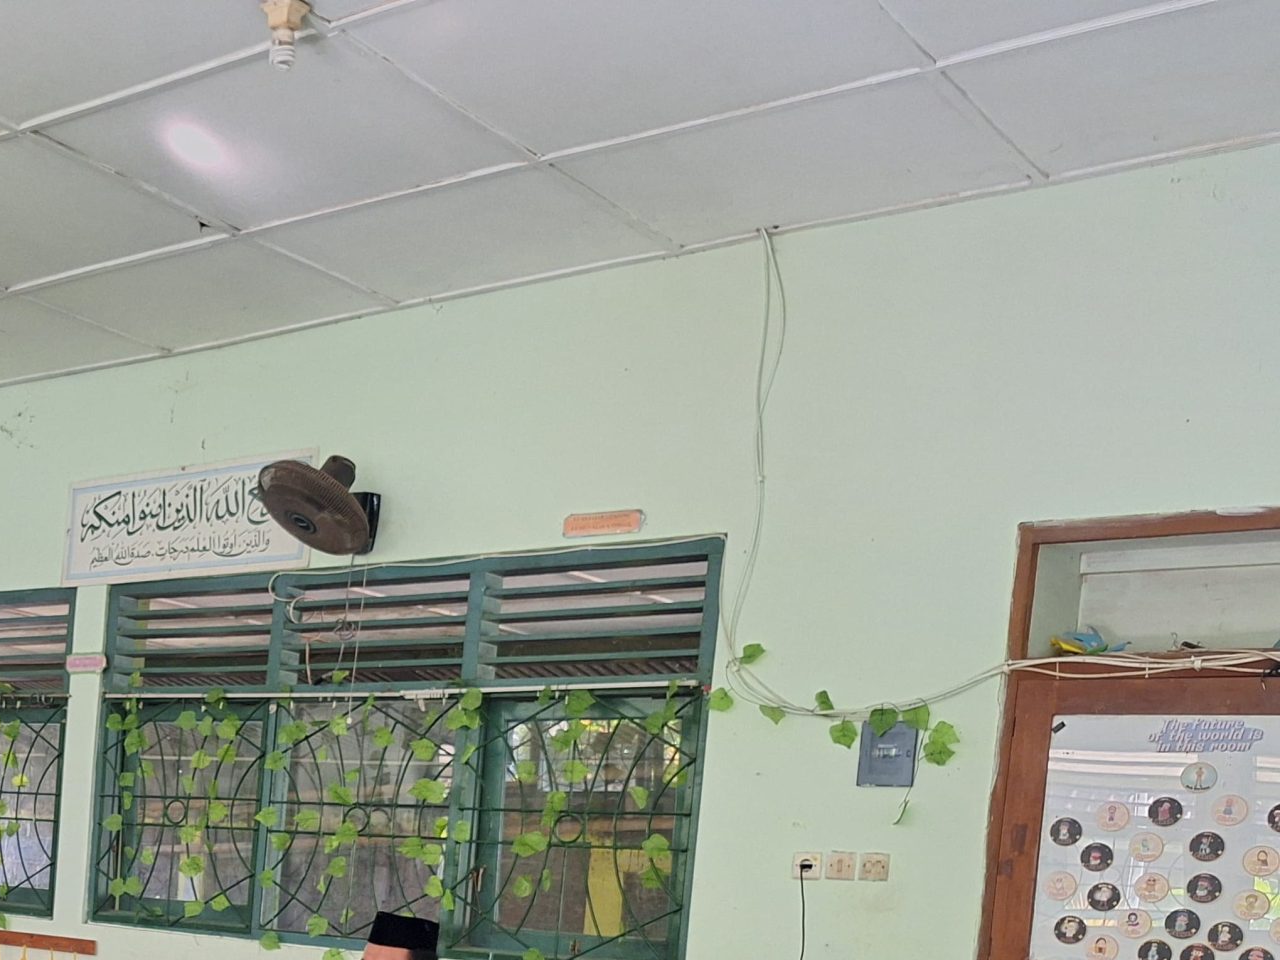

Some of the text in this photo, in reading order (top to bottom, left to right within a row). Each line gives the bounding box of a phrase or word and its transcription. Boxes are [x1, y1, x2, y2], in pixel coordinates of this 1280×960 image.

[1161, 718, 1187, 733] The
[1169, 730, 1193, 742] the
[1198, 728, 1245, 741] world
[1175, 740, 1204, 752] this
[1209, 741, 1252, 752] room
